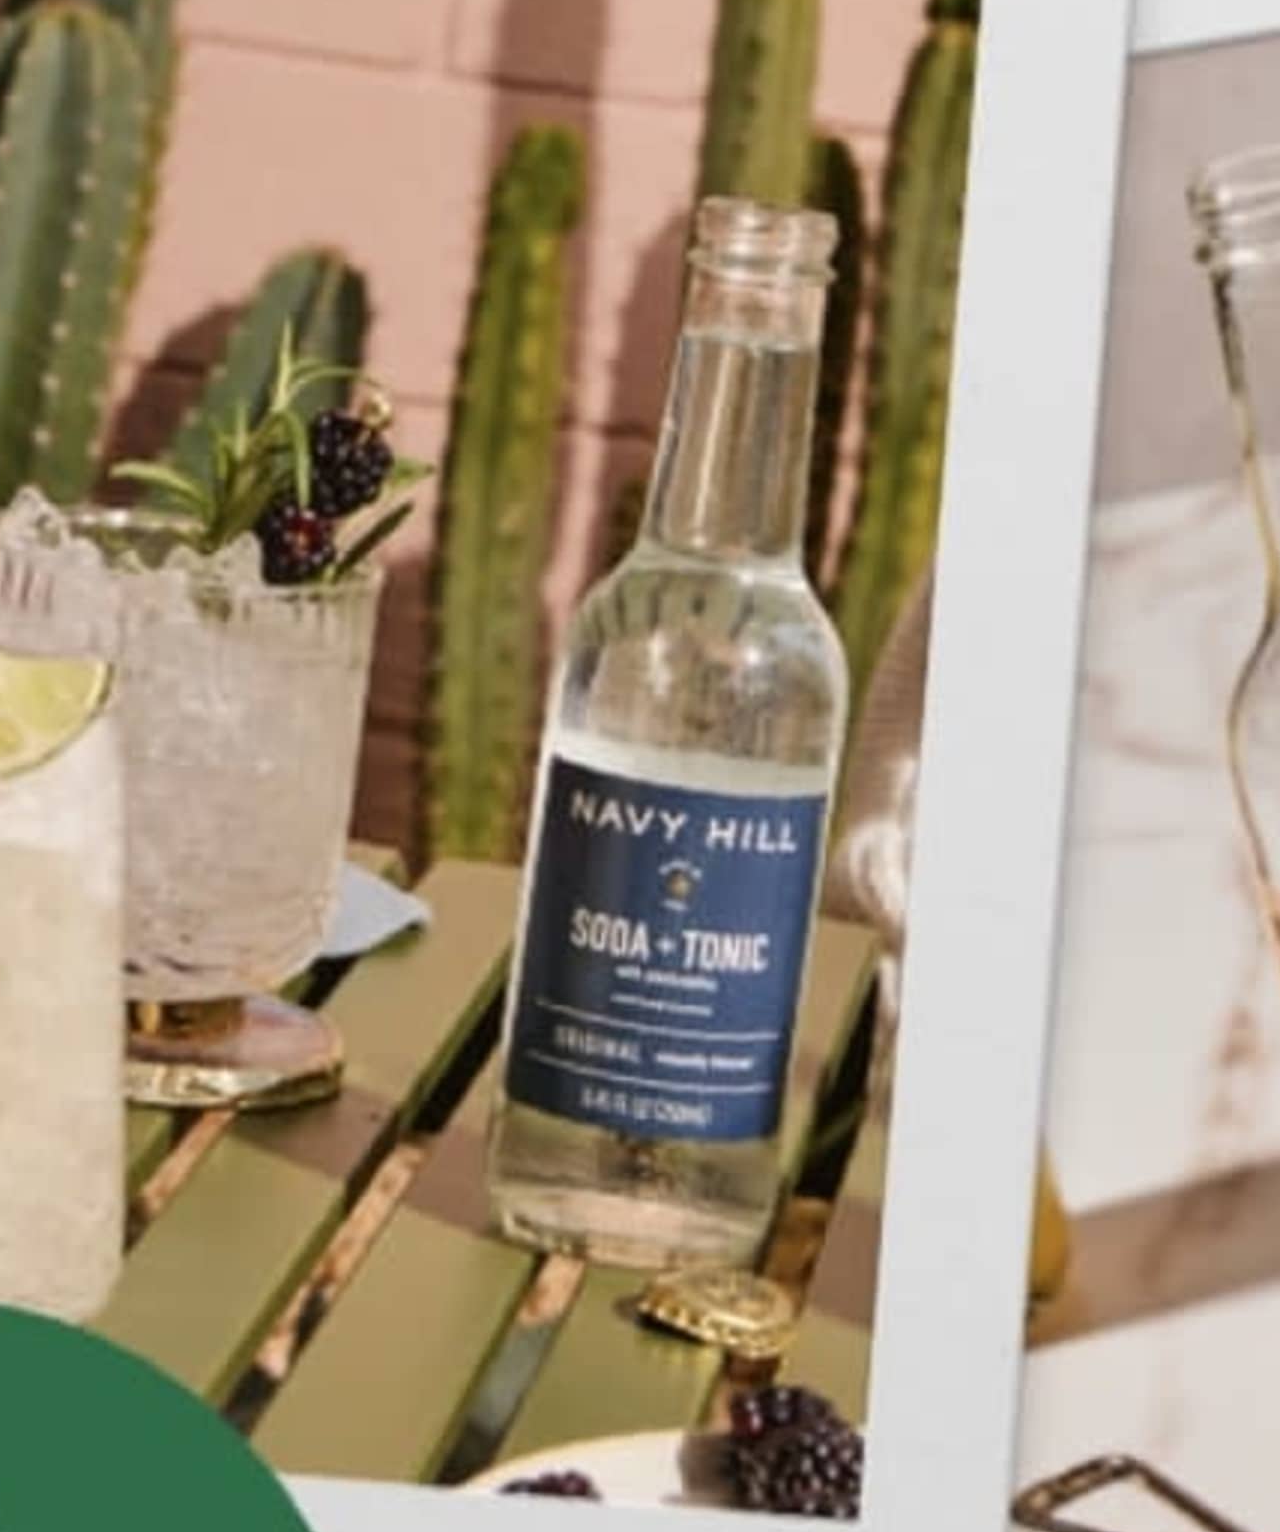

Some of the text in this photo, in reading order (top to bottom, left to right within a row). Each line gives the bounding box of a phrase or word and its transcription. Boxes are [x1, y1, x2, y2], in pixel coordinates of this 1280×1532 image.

[568, 789, 798, 854] NAVY HILL
[569, 907, 651, 961] SODA
[681, 929, 771, 975] TONIC
